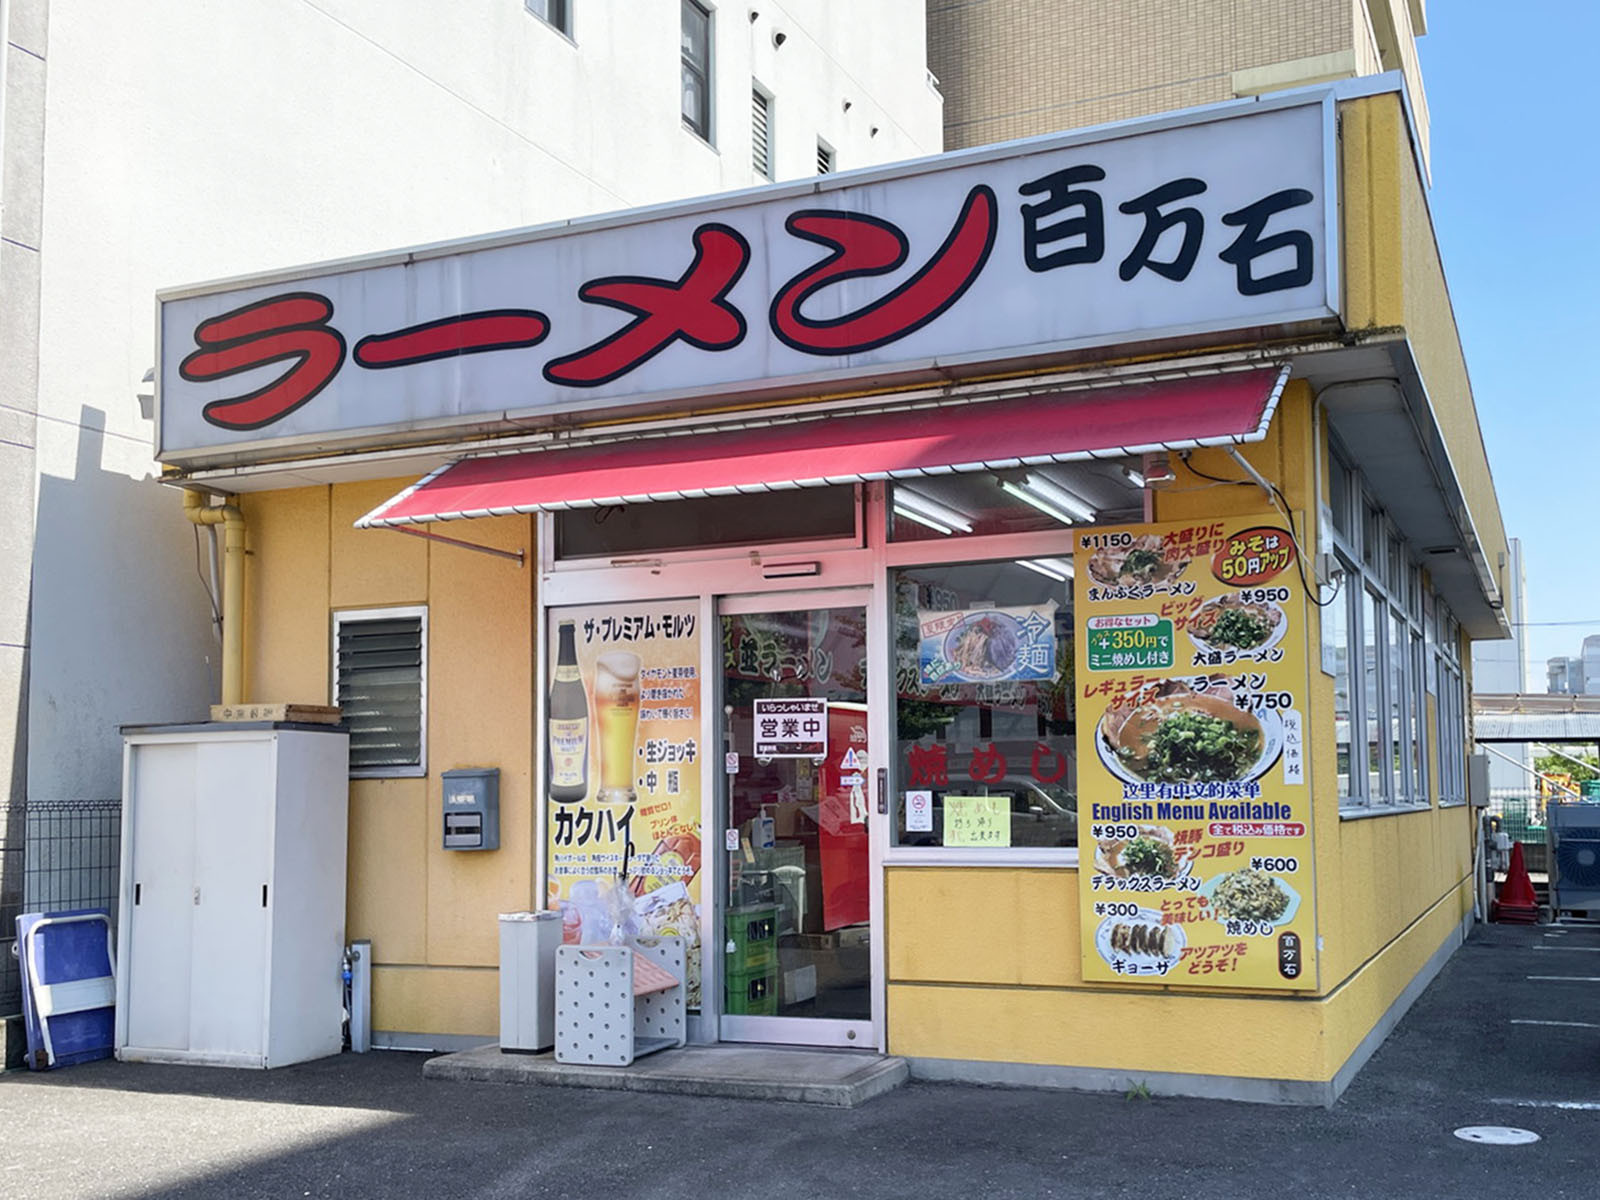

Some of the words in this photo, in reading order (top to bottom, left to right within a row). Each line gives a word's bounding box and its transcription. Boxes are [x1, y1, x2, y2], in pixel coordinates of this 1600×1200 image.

[180, 184, 997, 431] ラーメン
[1019, 164, 1314, 297] 百万石
[1081, 533, 1132, 547] ¥1150
[1163, 523, 1224, 546] 大盛りに
[1165, 539, 1225, 562] 肉大盛り
[1230, 536, 1279, 555] みそは
[1221, 548, 1290, 580] 50円アップ
[1241, 588, 1289, 602] ¥950
[1161, 595, 1204, 617] ビッグ
[1095, 616, 1151, 628] お得なセット
[1174, 610, 1218, 631] サイズ
[1016, 611, 1051, 674] 冷麺
[1091, 651, 1169, 667] ミニ焼めし付き
[1193, 649, 1283, 666] 大盛ラーメン
[1083, 675, 1160, 698] レギュラー
[1193, 674, 1266, 692] ラーメン
[1111, 687, 1158, 710] サイズ
[1236, 693, 1292, 709] ¥750
[761, 703, 819, 712] いらっしゃいませ
[760, 718, 820, 738] 営業中
[908, 741, 1067, 786] 焼めし
[1123, 782, 1261, 799] 这里有中文的菜单
[1092, 803, 1153, 822] English
[1157, 802, 1204, 820] Menu
[1209, 801, 1291, 820] Available
[554, 805, 635, 846] カクハイ
[1092, 825, 1137, 838] ¥950
[1212, 824, 1301, 836] 全て税込み価格です
[1174, 829, 1203, 846] 焼豚
[1173, 841, 1245, 862] テンコ盛り
[1251, 858, 1297, 872] ¥600
[1091, 876, 1201, 891] デラックスラーメン
[1095, 904, 1138, 916] ¥300
[1160, 896, 1209, 911] とっても
[1161, 908, 1219, 925] 美味しい!
[1226, 921, 1274, 936] 焼めし
[1179, 942, 1248, 960] アツアツを
[1282, 935, 1297, 975] 百万石
[1112, 959, 1169, 976] ギョーザ
[1188, 959, 1237, 974] どうぞ!
